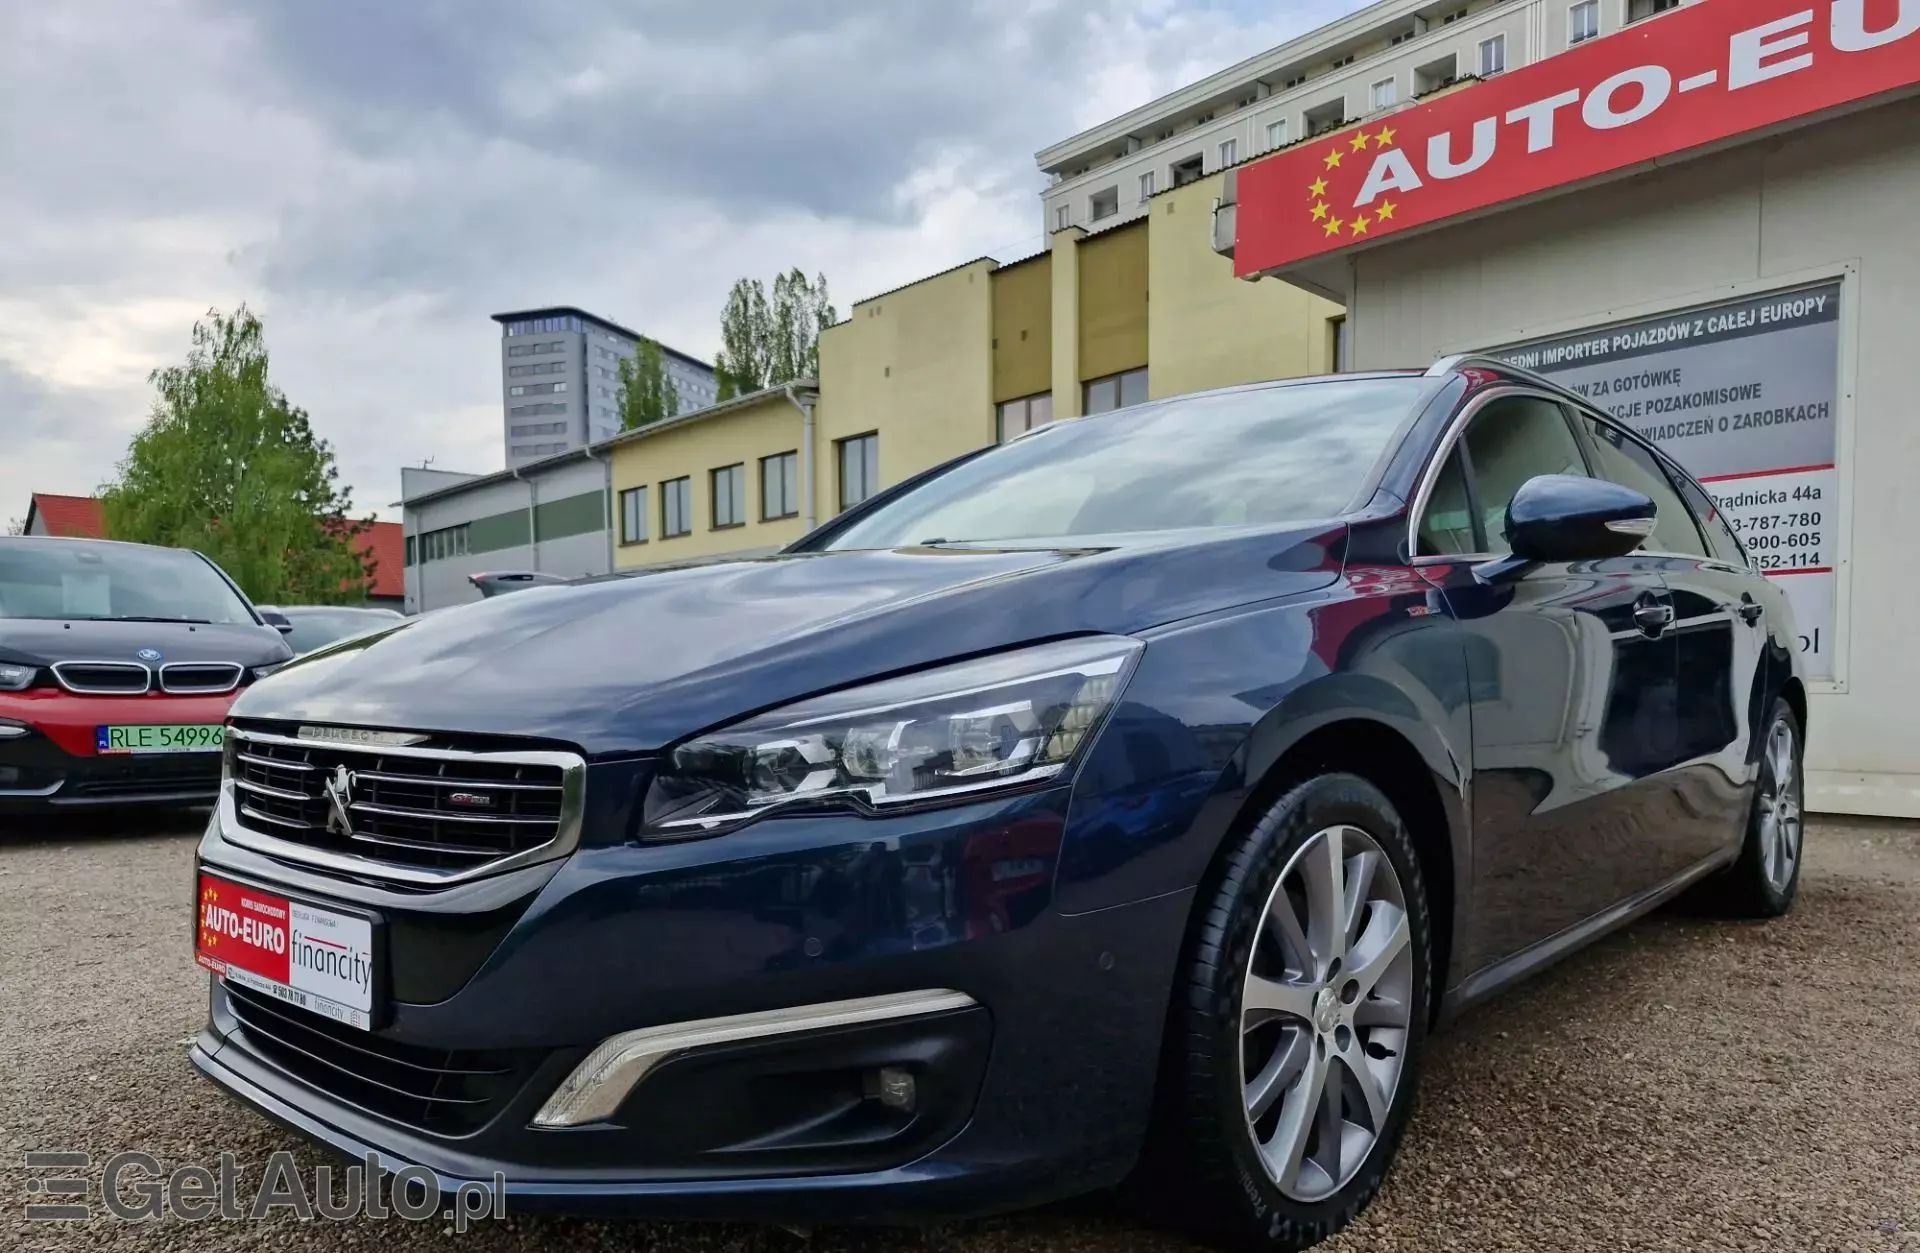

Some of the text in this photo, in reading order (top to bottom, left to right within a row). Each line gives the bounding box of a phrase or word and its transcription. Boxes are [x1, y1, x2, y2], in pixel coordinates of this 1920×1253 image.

[1353, 0, 1920, 208] AUTO-EU
[1543, 341, 1608, 366] IMPORTER
[1612, 320, 1690, 352] POJAZDÓW
[1692, 319, 1704, 337] Z
[1707, 309, 1756, 333] CAŁEJ
[1760, 295, 1827, 324] EUROPY
[1592, 381, 1609, 397] ZA
[1613, 368, 1682, 393] GOTÓWKĘ
[1645, 383, 1762, 416] POZAKOMISOWE
[1718, 416, 1729, 433] O
[1732, 401, 1829, 431] ZAROBKACH
[1792, 485, 1822, 501] 44a
[1732, 512, 1822, 532] 3-787-780
[110, 727, 153, 749] RLE
[160, 727, 223, 746] 54996
[205, 903, 285, 954] AUTO-EURO
[292, 929, 372, 995] financity
